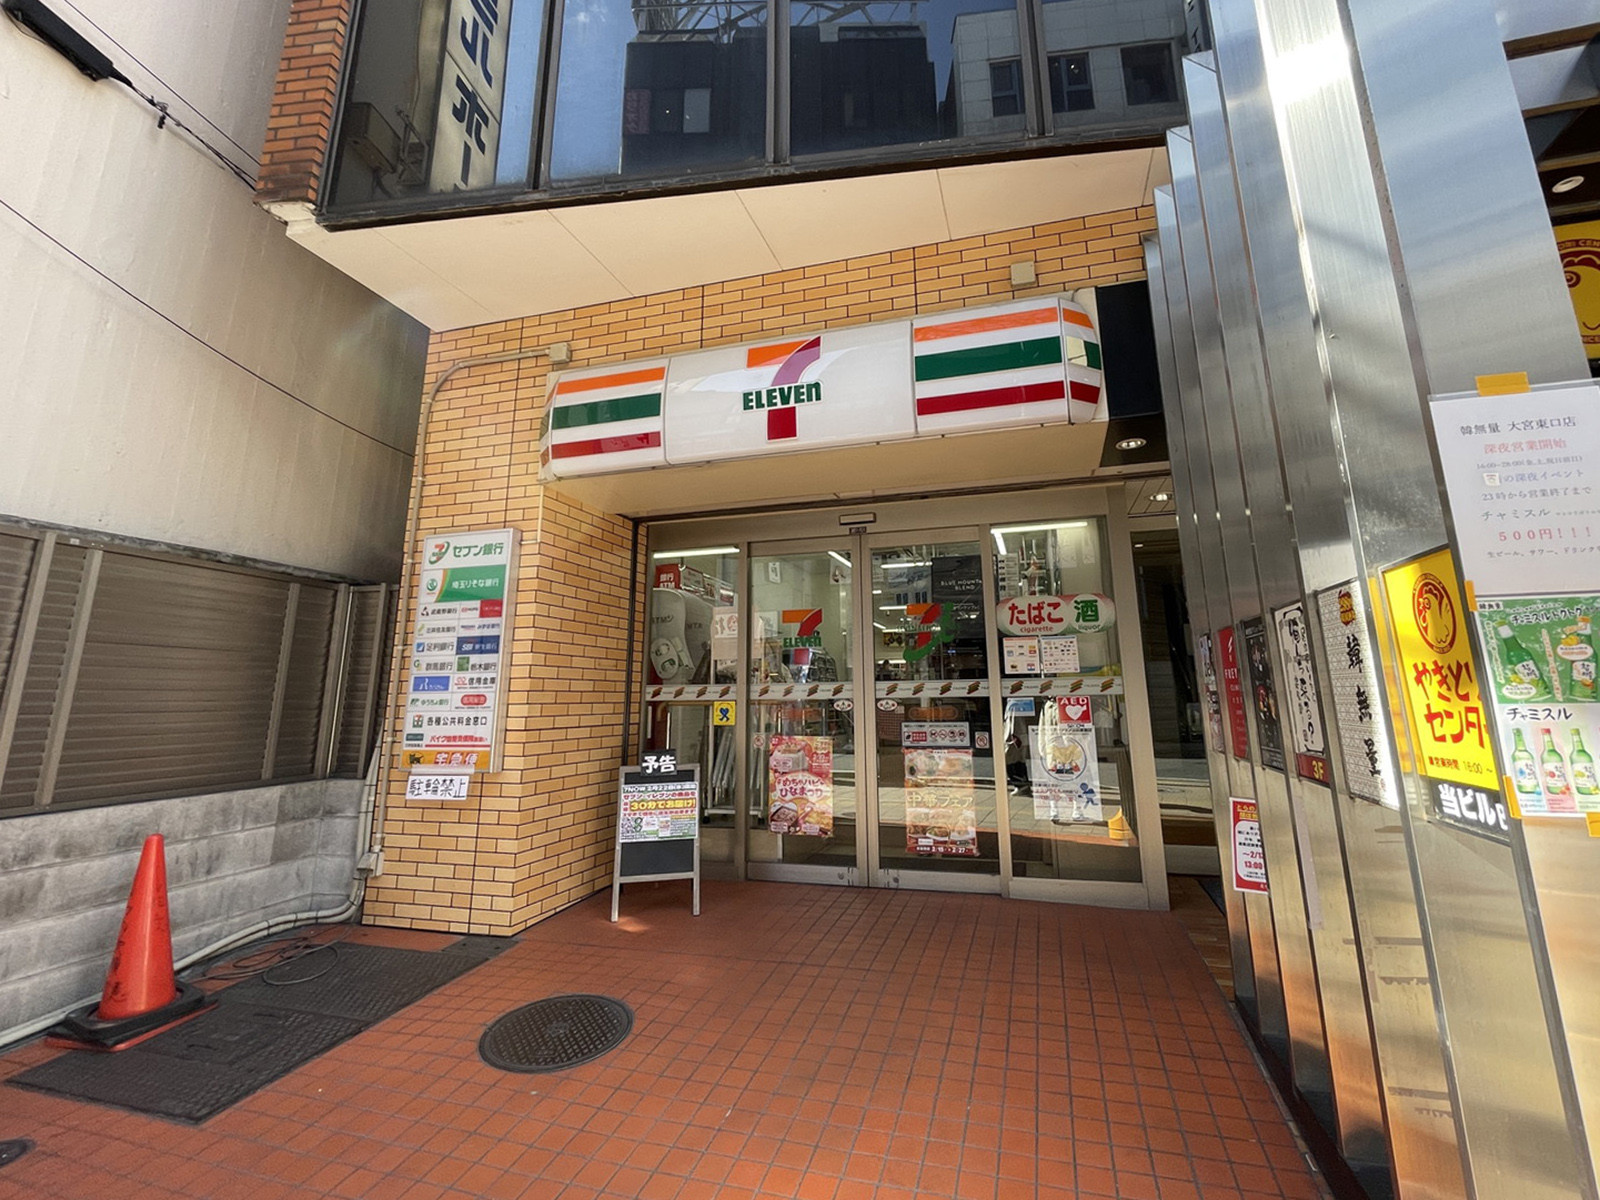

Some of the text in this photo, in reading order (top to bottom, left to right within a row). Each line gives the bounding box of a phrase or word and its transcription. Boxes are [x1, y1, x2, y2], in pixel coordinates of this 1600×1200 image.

[1460, 416, 1577, 436] 韓無量 大宮東口店
[1484, 438, 1567, 454] 深夜営業開始
[1481, 487, 1592, 501] 23時から営業終了まで
[453, 542, 504, 558] セブン銀行
[451, 578, 500, 589] 埼玉りそな銀行
[1008, 599, 1099, 626] たばこ 酒
[1020, 624, 1101, 634] cigarette liquor
[1059, 696, 1088, 705] AED
[426, 716, 488, 726] 各種公共料金窓口
[1506, 707, 1574, 721] チャミスル
[1423, 703, 1489, 749] センタ
[641, 755, 677, 774] 予告
[1312, 761, 1324, 780] 3F
[408, 778, 467, 798] 駐輪禁止
